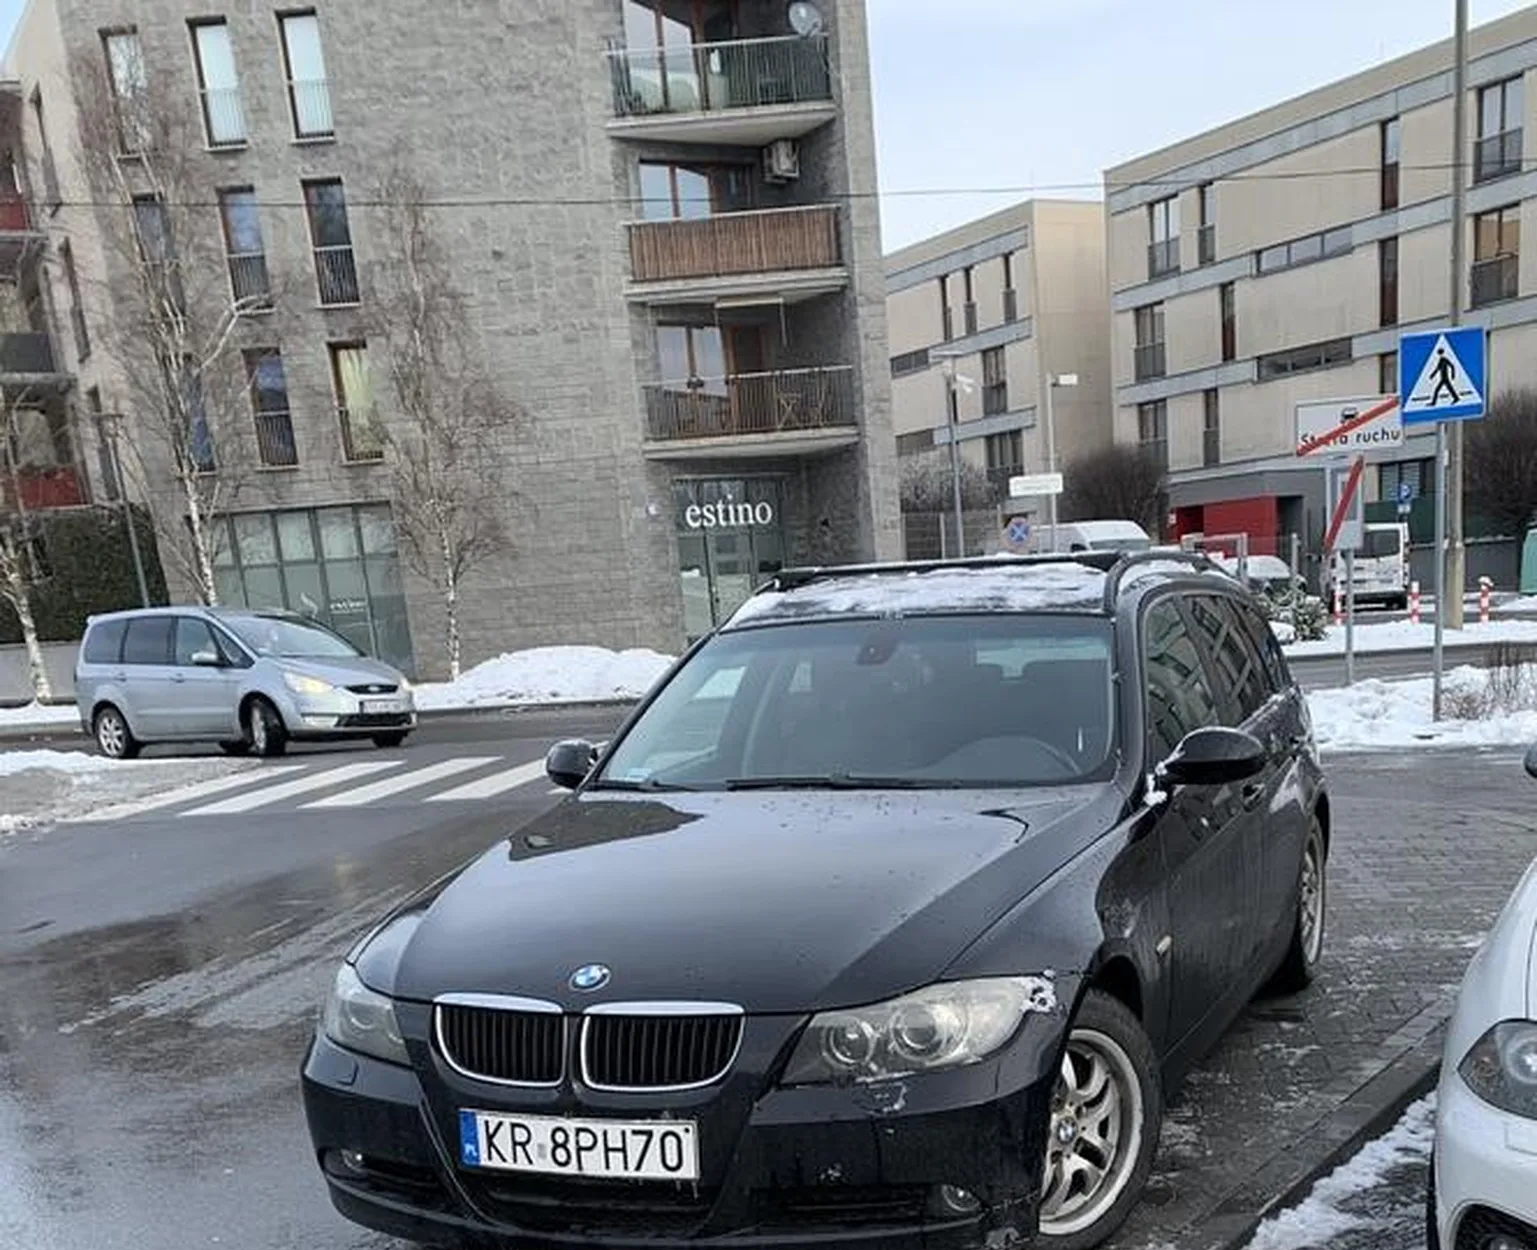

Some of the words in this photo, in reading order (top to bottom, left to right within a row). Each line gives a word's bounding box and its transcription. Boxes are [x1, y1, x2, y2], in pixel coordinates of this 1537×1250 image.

[1356, 427, 1400, 443] ruchu
[685, 494, 772, 528] estino
[484, 1119, 534, 1165] KR
[550, 1126, 684, 1172] 8PH70
